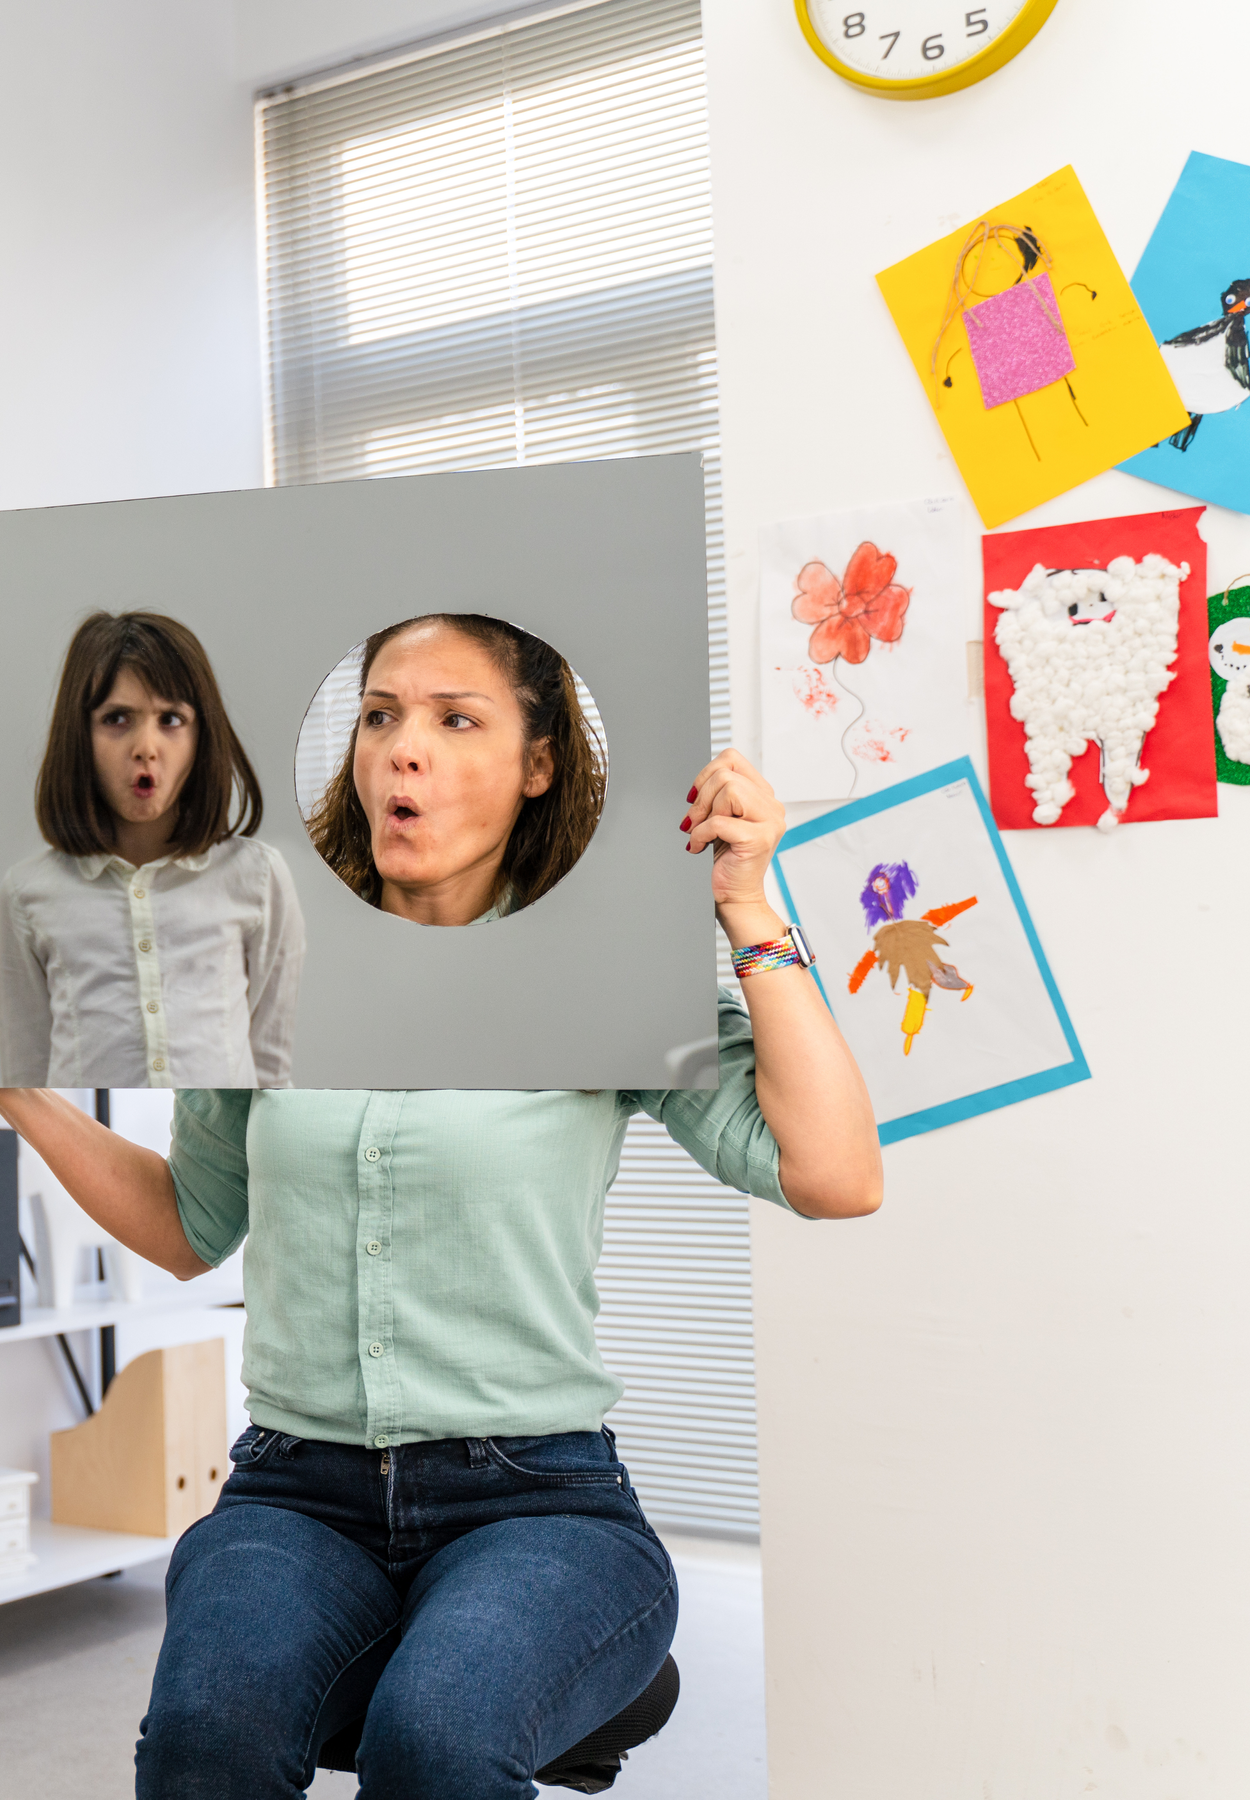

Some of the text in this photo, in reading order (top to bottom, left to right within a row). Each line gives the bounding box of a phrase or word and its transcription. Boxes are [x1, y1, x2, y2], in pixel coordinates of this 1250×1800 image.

[843, 12, 866, 39] 8
[964, 8, 989, 38] 5
[879, 30, 901, 60] 7
[921, 33, 945, 61] 6
